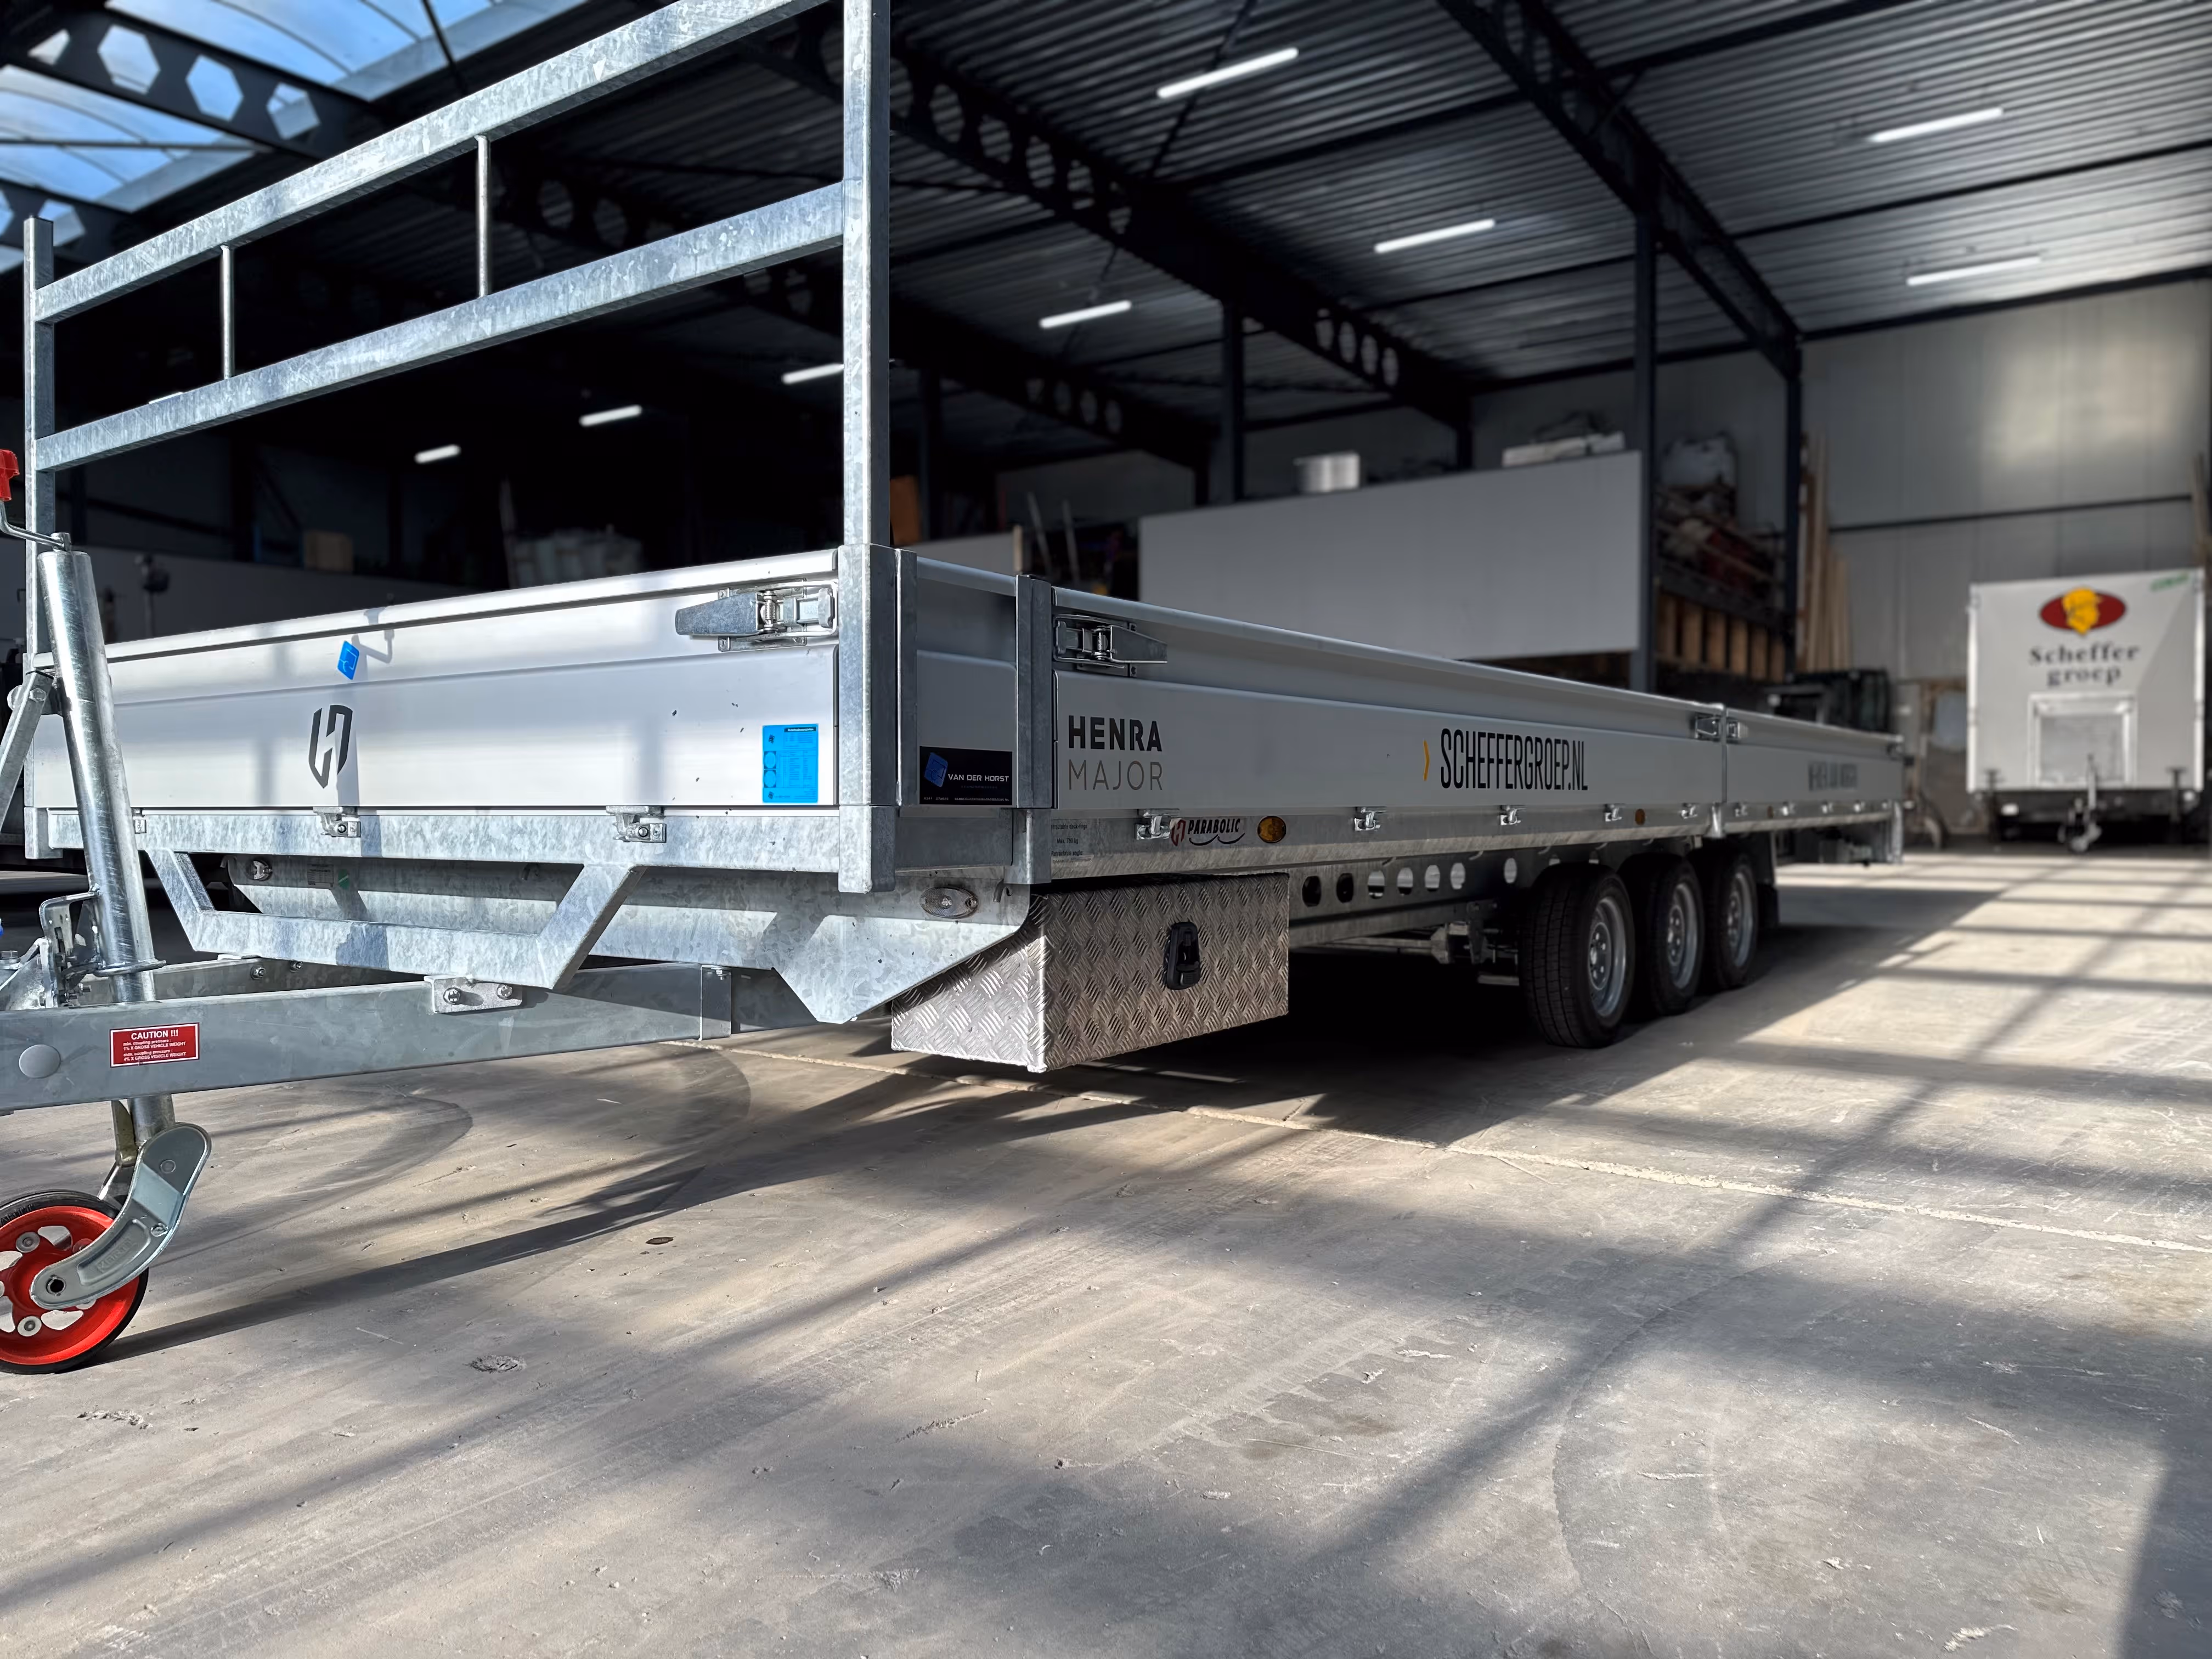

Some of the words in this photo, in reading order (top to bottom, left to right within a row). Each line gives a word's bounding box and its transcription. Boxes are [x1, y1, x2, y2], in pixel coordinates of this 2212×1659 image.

[2029, 641, 2140, 666] Scheffer
[2047, 667, 2121, 687] groep
[1069, 715, 1162, 752] HENRA
[1441, 728, 1588, 791] SCHEFFERGROEP.NL
[1069, 759, 1163, 790] MAJOR
[1188, 818, 1240, 834] PARABOLIC
[131, 1030, 168, 1040] CAUTION
